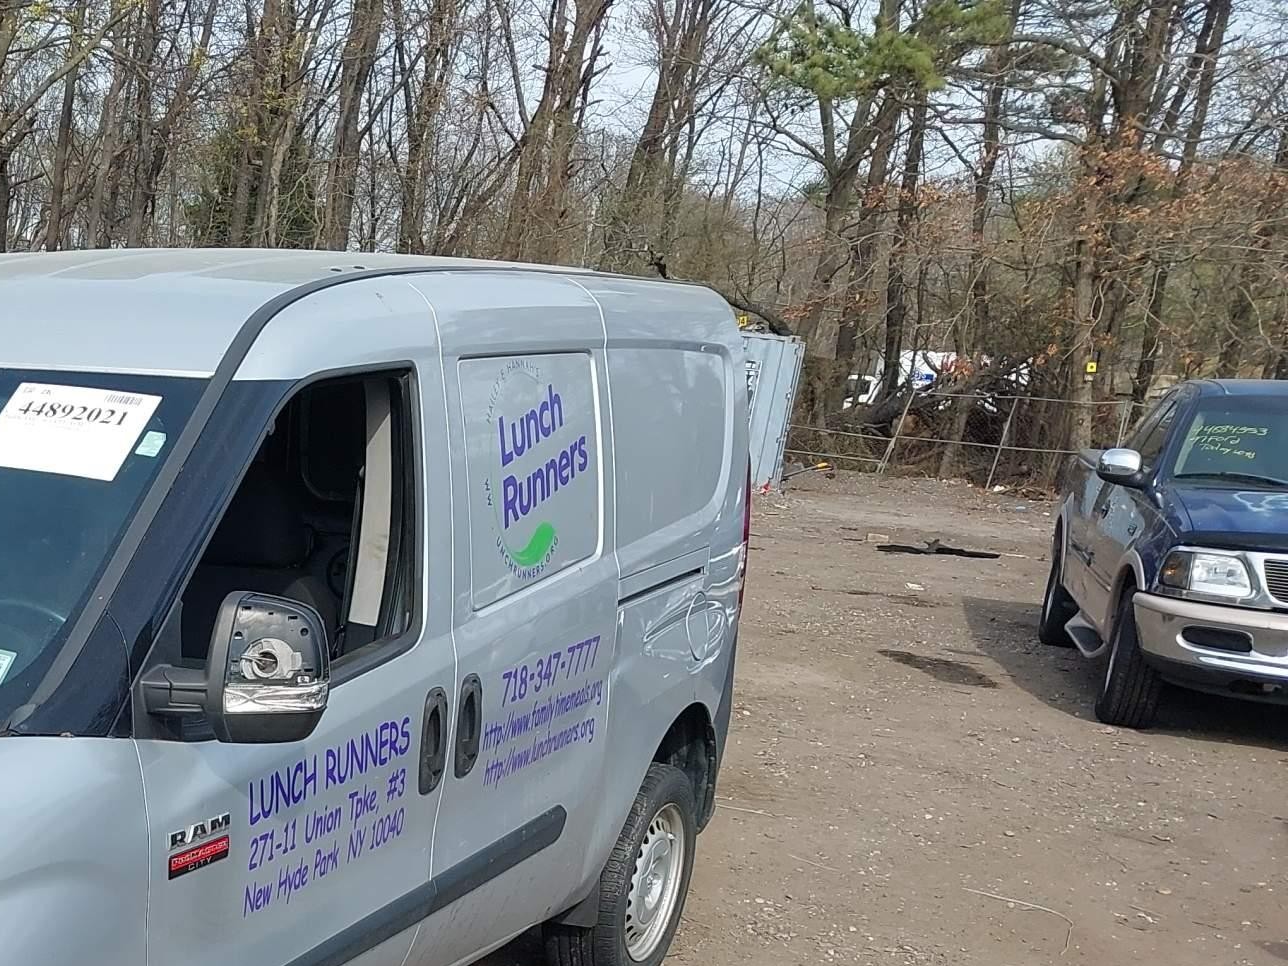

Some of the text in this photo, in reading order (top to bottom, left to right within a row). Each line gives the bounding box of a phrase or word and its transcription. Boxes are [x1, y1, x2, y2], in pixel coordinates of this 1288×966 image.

[18, 401, 128, 425] 44892021
[498, 384, 564, 467] Lunch
[502, 436, 588, 529] Runners
[502, 635, 601, 707] 718-347-7777
[249, 716, 410, 826] LUNCH RUNNERS
[483, 718, 595, 790] http://www.lunchrunners.org
[168, 812, 230, 851] RAM
[248, 819, 297, 870] 271-11
[305, 805, 342, 843] Union
[387, 768, 406, 803] #3
[187, 856, 213, 871] CITY
[243, 807, 405, 918] New Hyde Park NY 10040
